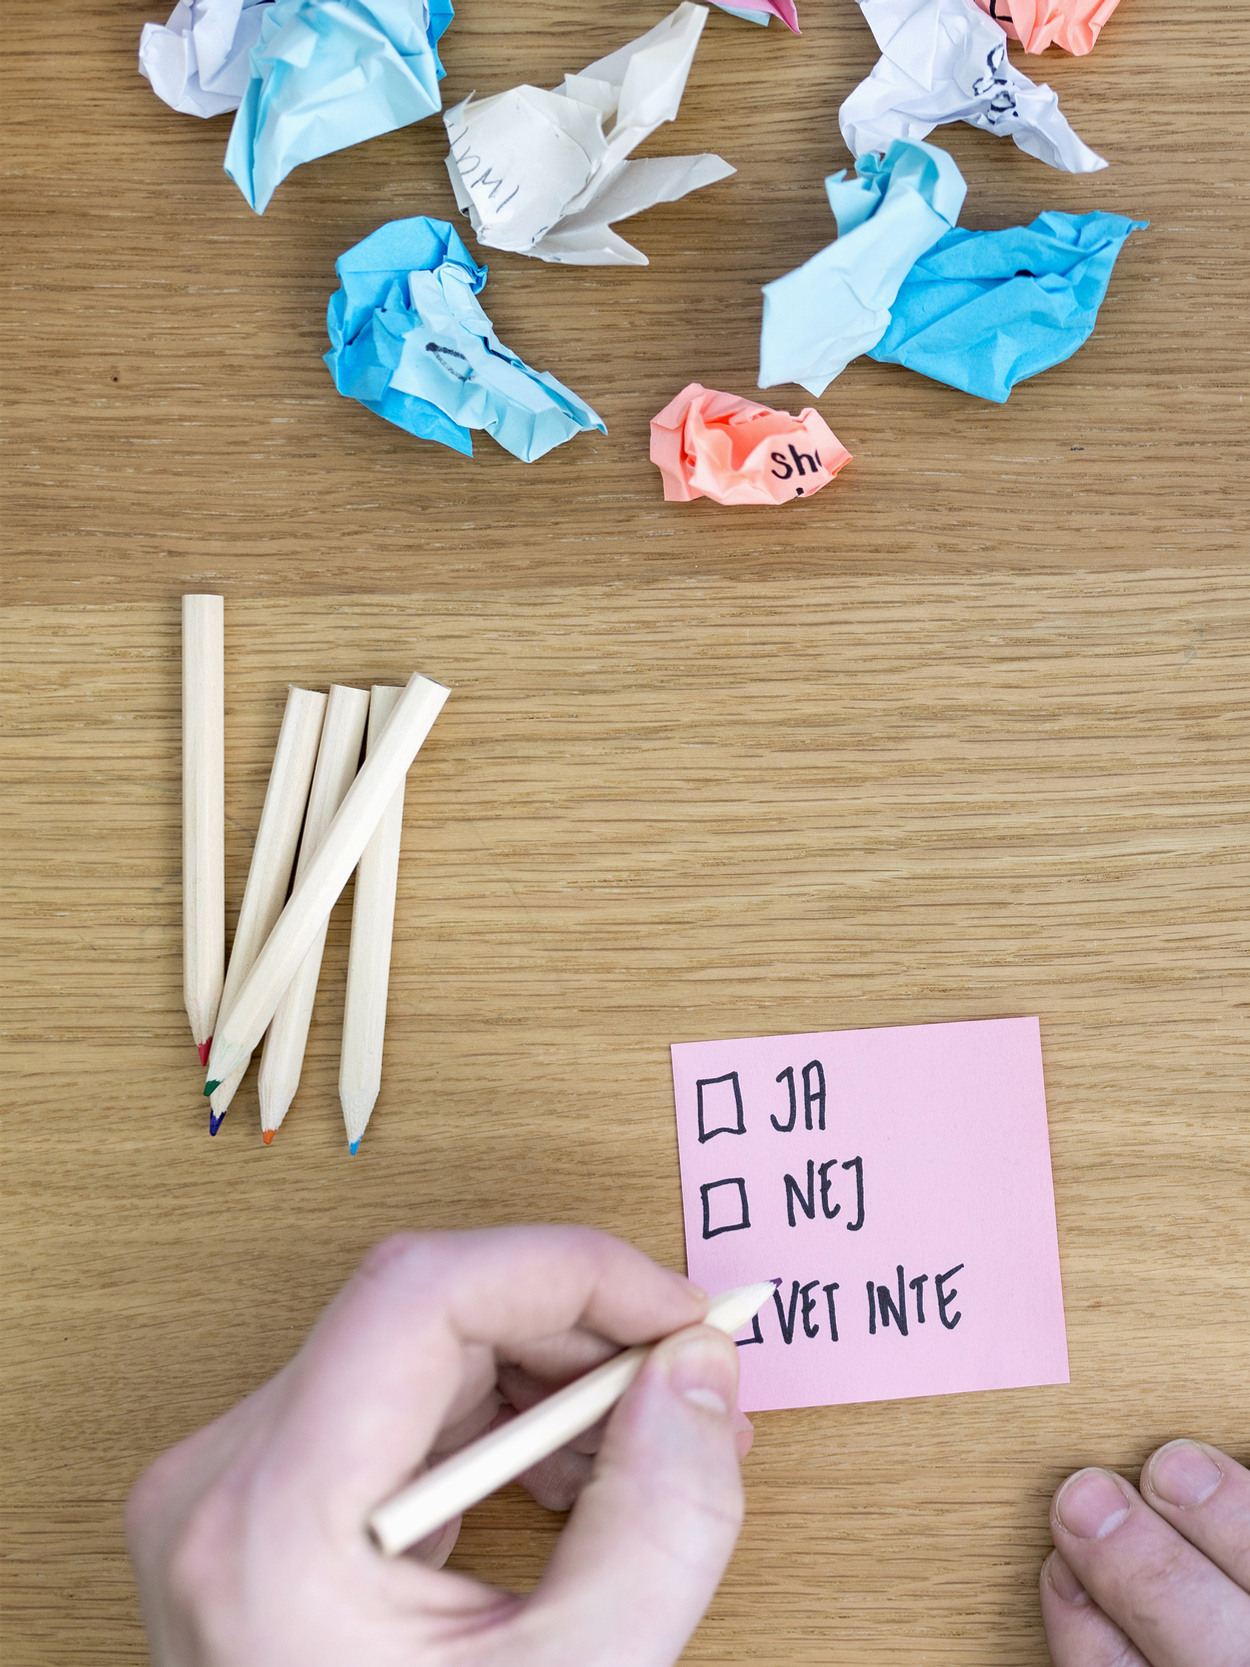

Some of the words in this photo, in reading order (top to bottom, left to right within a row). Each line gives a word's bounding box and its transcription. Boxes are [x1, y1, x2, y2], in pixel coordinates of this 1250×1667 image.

[769, 1059, 827, 1133] JA
[783, 1155, 866, 1232] NEJ
[772, 1279, 840, 1345] VET
[865, 1263, 965, 1344] INTE
